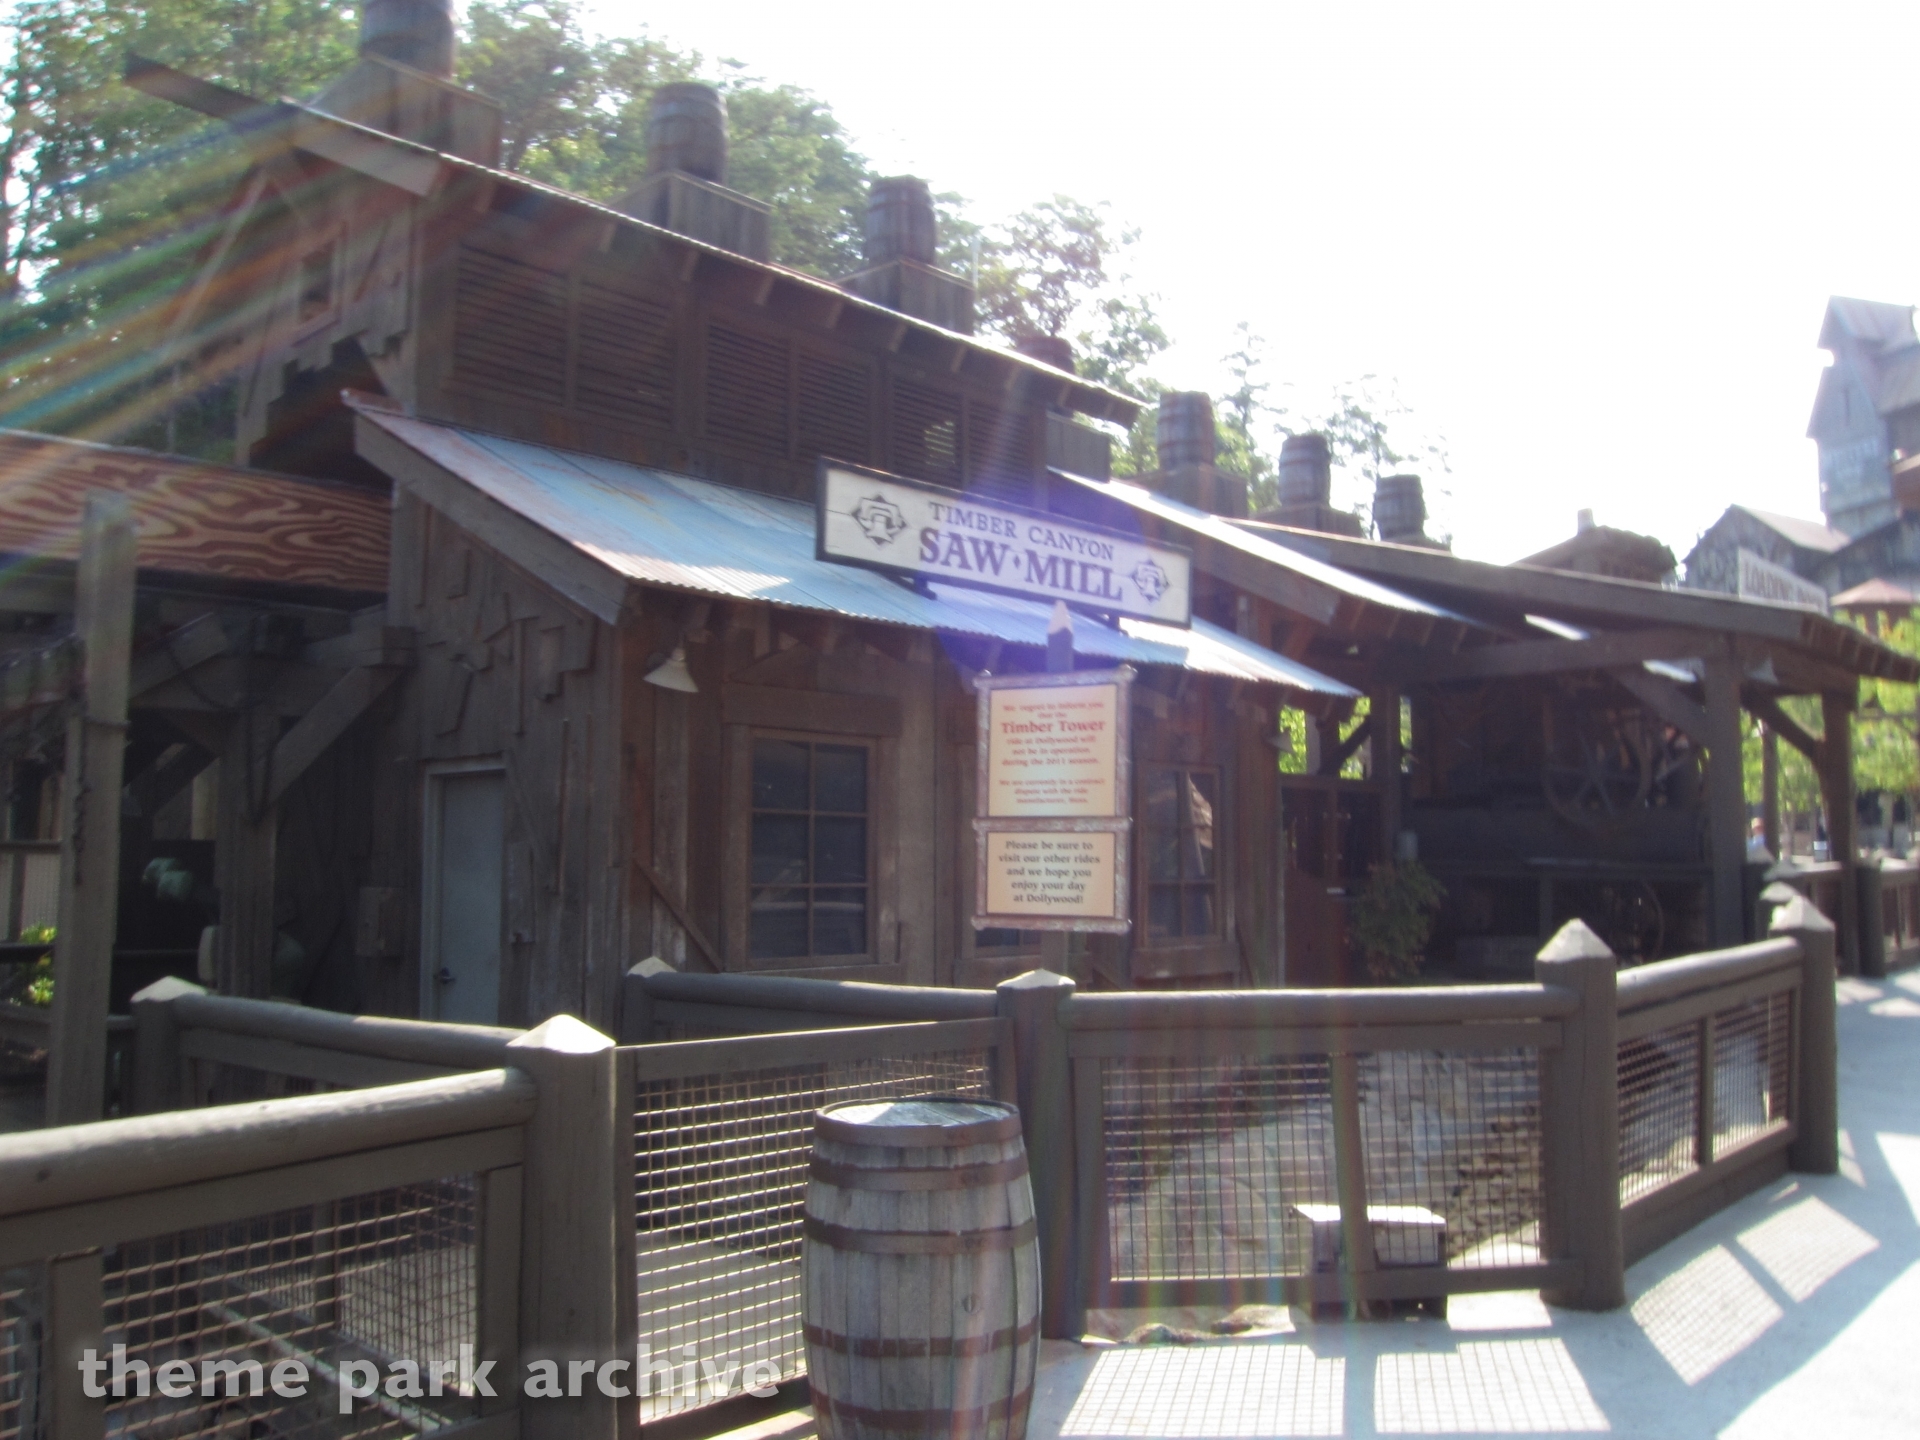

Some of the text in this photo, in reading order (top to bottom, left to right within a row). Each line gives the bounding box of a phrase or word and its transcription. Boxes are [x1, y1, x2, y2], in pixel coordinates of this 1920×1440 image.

[928, 501, 1113, 562] TIMBER CANYON
[919, 526, 1122, 601] SAW MILL
[1001, 720, 1105, 734] Timber Tower
[1035, 736, 1078, 745] Dollywood
[1005, 841, 1038, 850] Please
[1041, 841, 1054, 849] be
[999, 854, 1020, 862] visit
[1044, 855, 1070, 863] other
[1074, 855, 1100, 863] rides
[1006, 867, 1025, 876] and
[1045, 867, 1070, 878] hope
[1073, 869, 1092, 878] you
[1011, 880, 1085, 892] enjoy your day
[1027, 894, 1083, 905] Dollywood!
